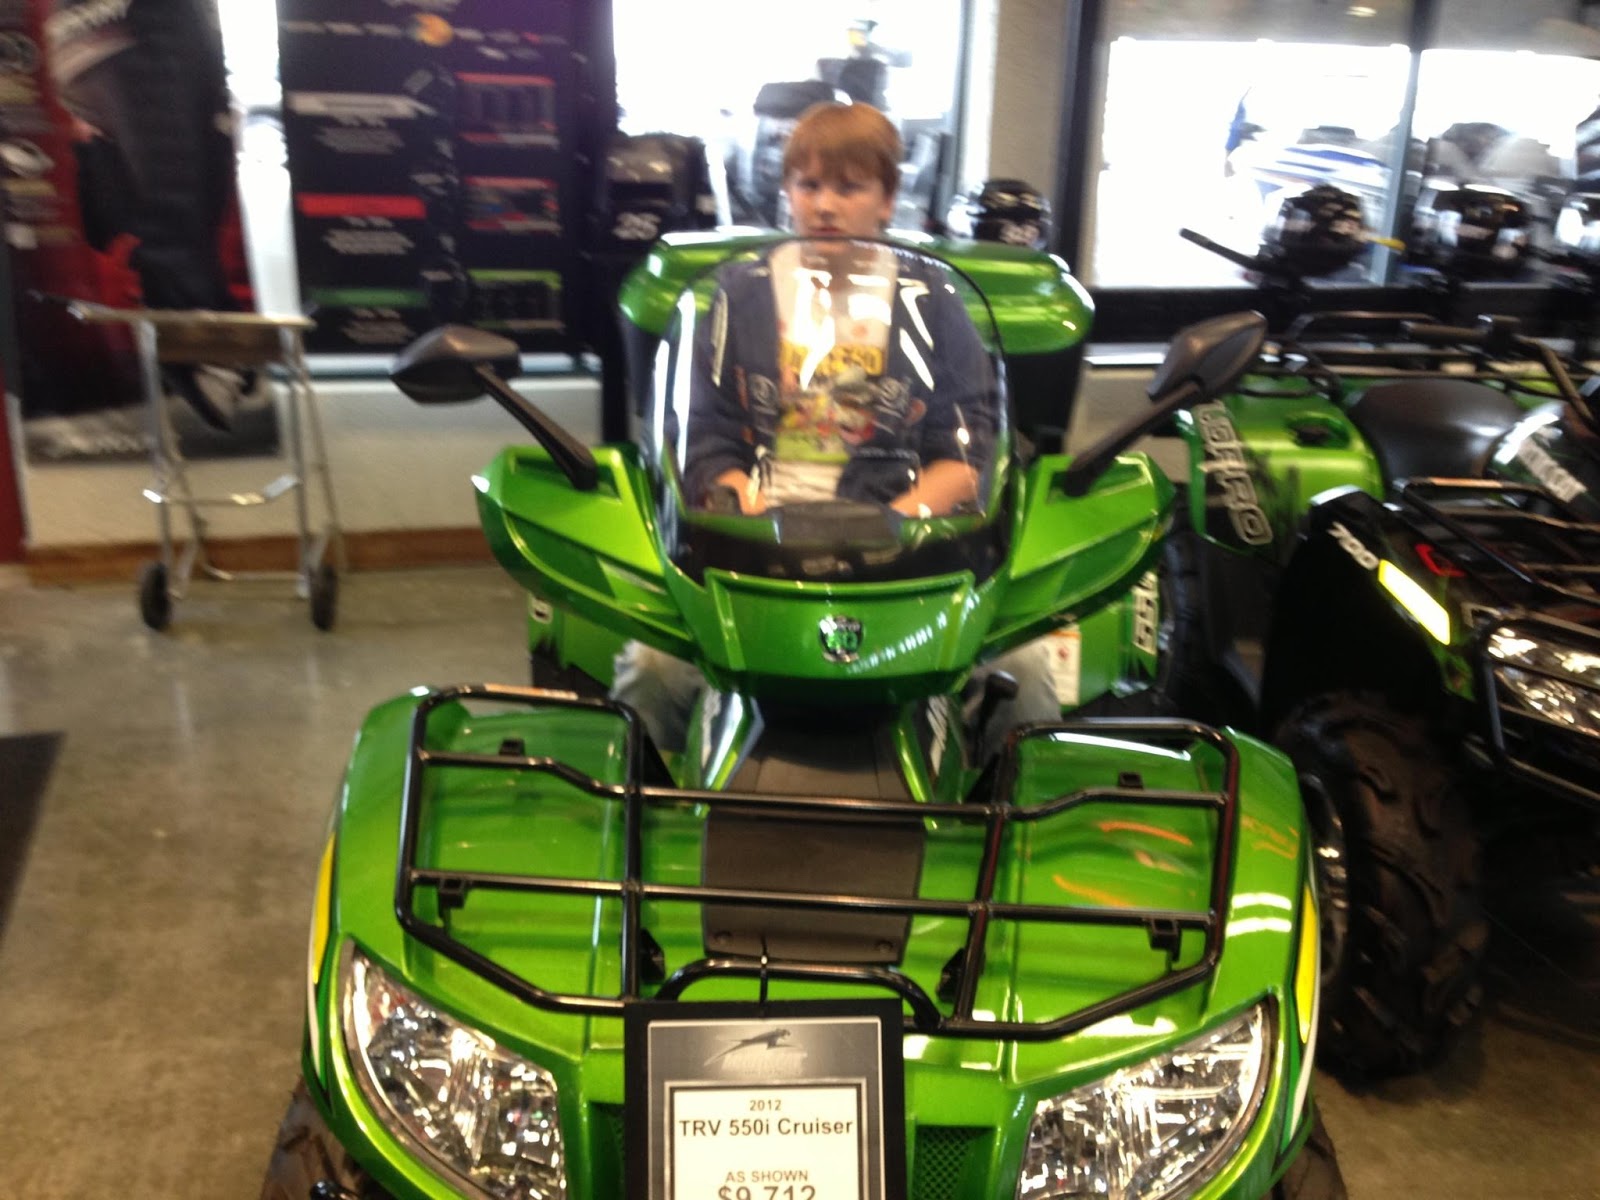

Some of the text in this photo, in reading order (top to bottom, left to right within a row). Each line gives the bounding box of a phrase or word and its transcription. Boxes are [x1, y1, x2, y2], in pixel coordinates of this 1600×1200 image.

[749, 1099, 782, 1112] 2012
[679, 1117, 853, 1137] TRV 550i Cruiser
[725, 1170, 809, 1183] AS SHOWN
